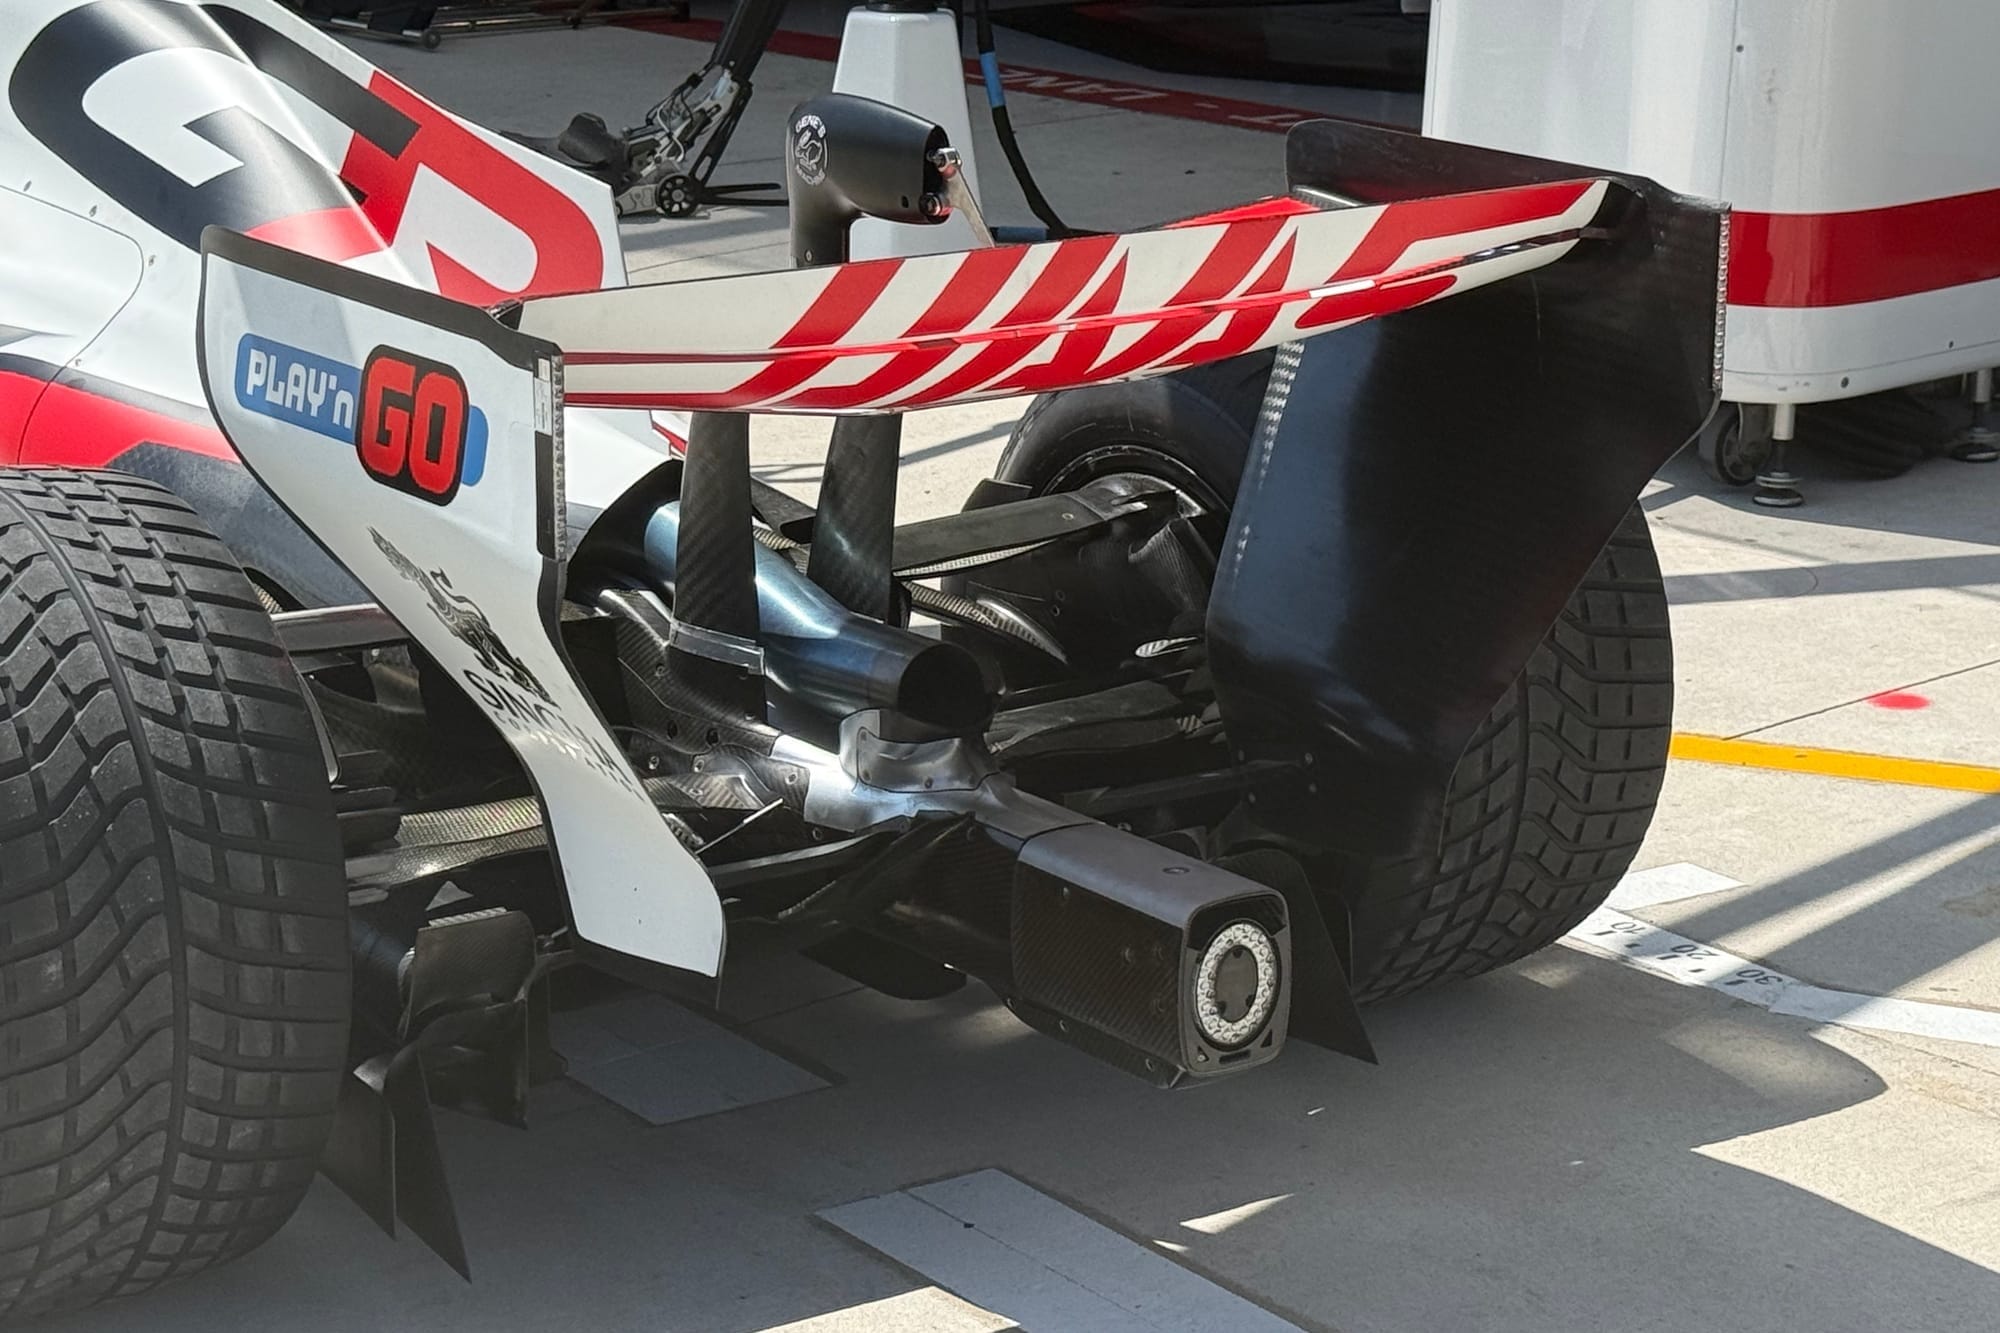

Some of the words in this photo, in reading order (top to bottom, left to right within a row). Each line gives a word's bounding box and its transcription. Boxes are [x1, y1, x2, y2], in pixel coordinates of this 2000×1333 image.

[245, 349, 354, 430] PLAY'n
[361, 354, 465, 496] GO
[1671, 943, 1719, 960] 20
[1735, 968, 1784, 986] 30
